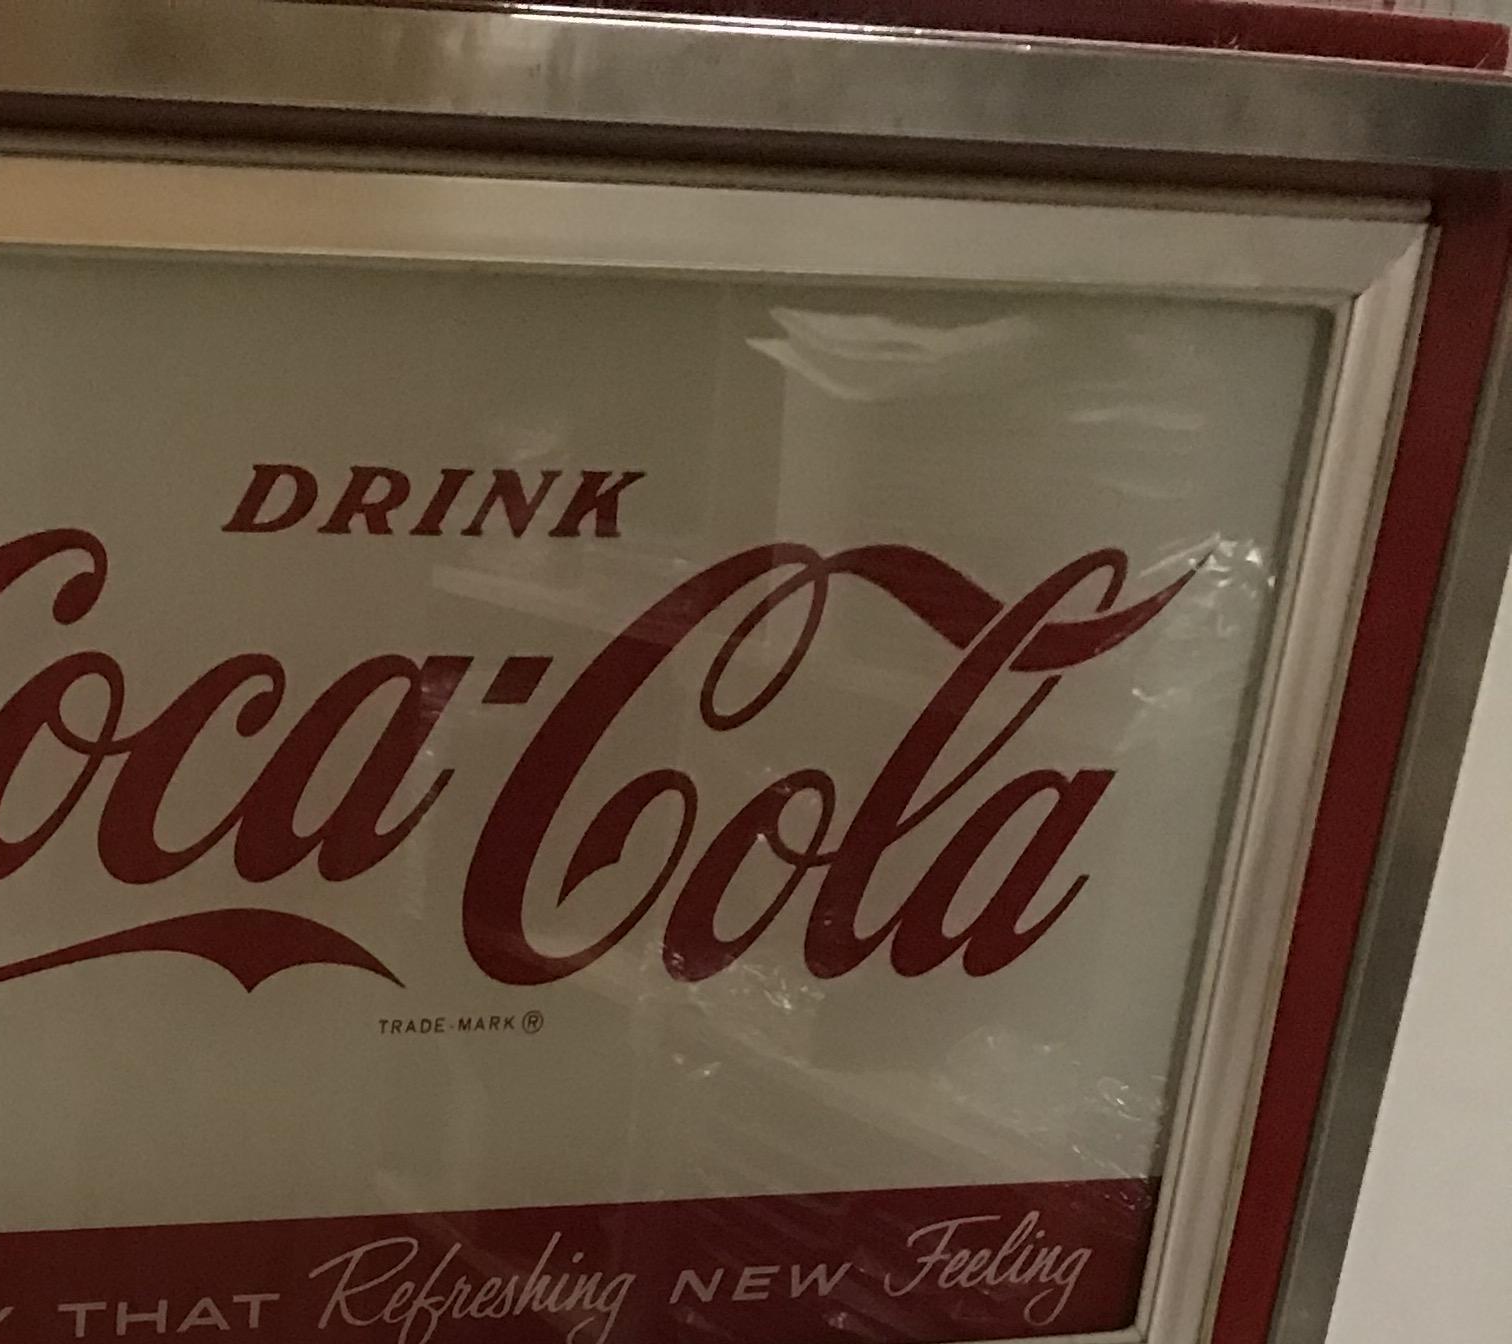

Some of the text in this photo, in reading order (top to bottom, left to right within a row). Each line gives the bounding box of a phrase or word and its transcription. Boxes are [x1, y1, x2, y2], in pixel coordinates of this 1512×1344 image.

[222, 463, 648, 539] DRINK
[57, 1293, 281, 1338] THAT
[669, 1261, 854, 1305] NEW
[884, 1210, 1092, 1325] Feeling
